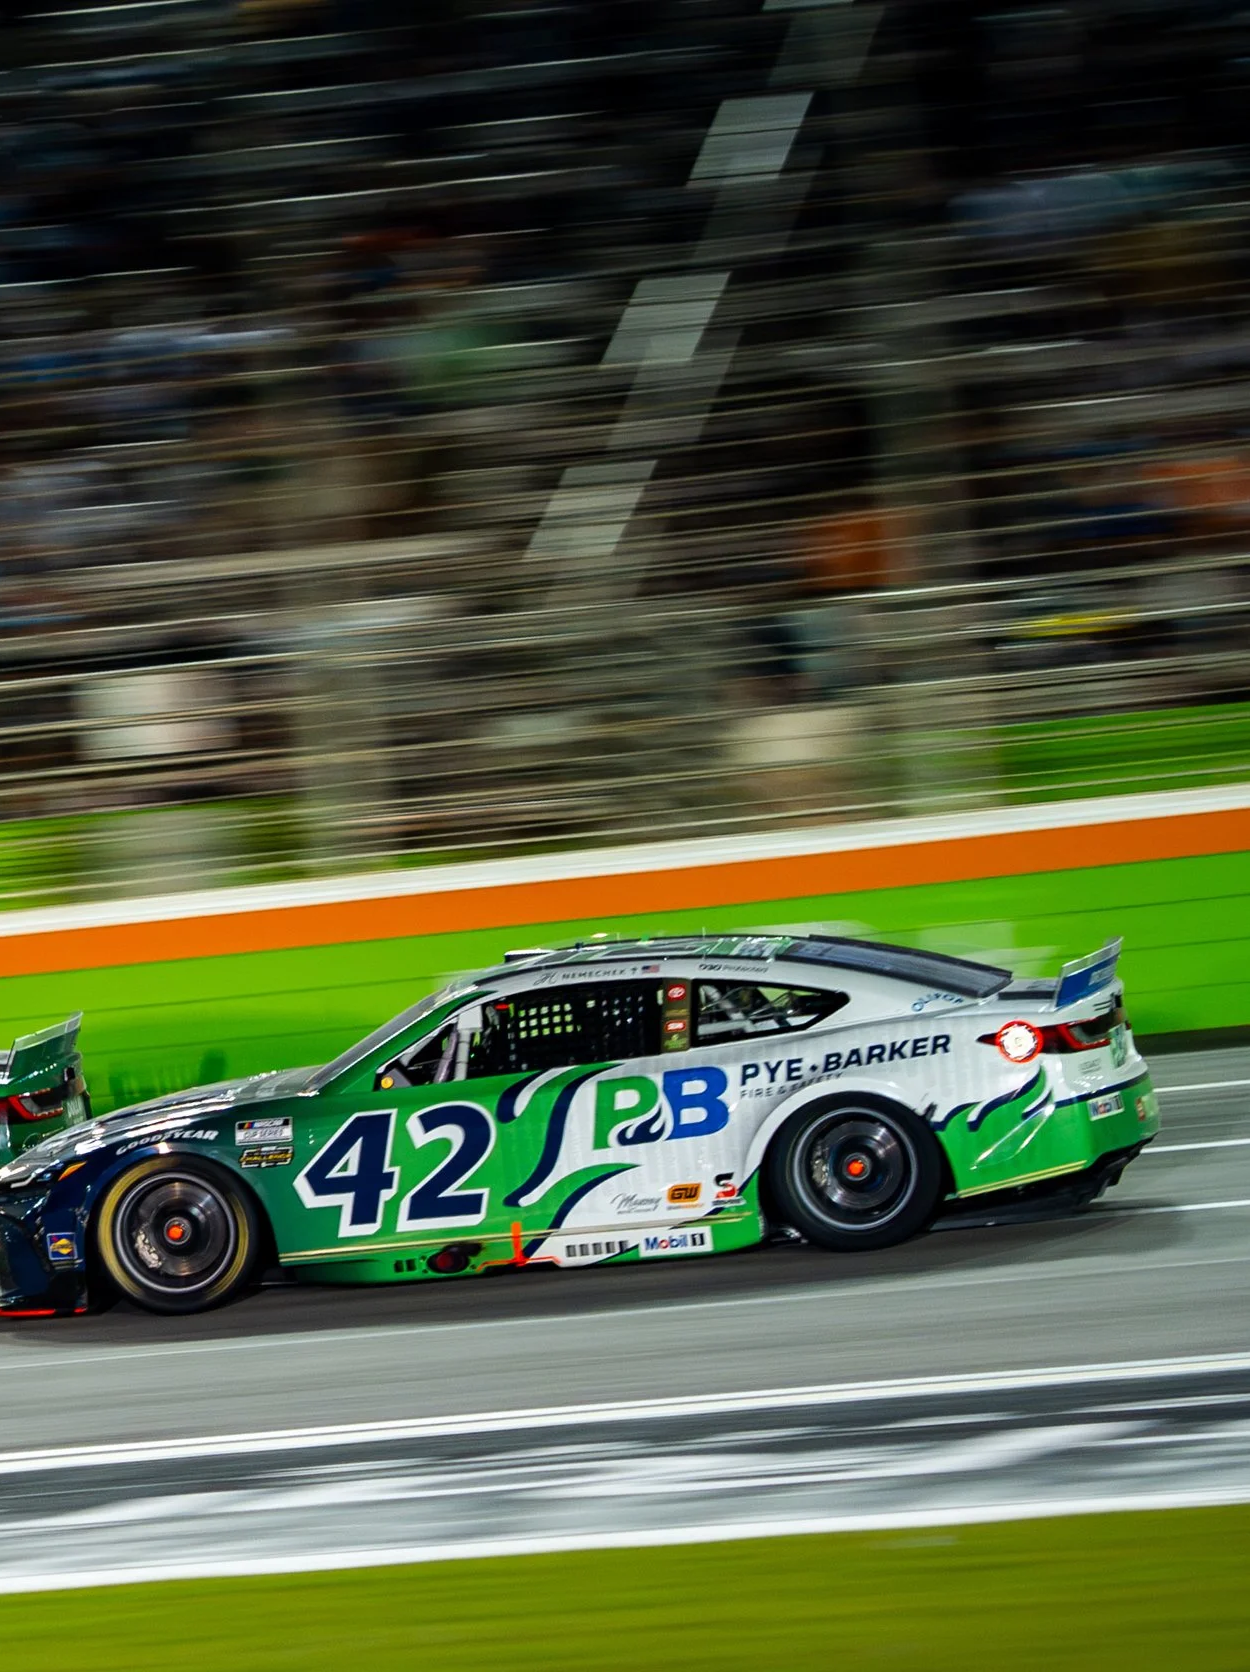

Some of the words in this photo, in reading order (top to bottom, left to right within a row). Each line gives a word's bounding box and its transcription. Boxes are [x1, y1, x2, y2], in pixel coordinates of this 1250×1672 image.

[739, 1058, 804, 1087] PYE
[823, 1034, 953, 1074] BARKER
[739, 1086, 774, 1099] FIRE
[115, 1129, 220, 1156] GOODYEAR
[293, 1100, 498, 1238] 42
[644, 1234, 689, 1251] Mobil
